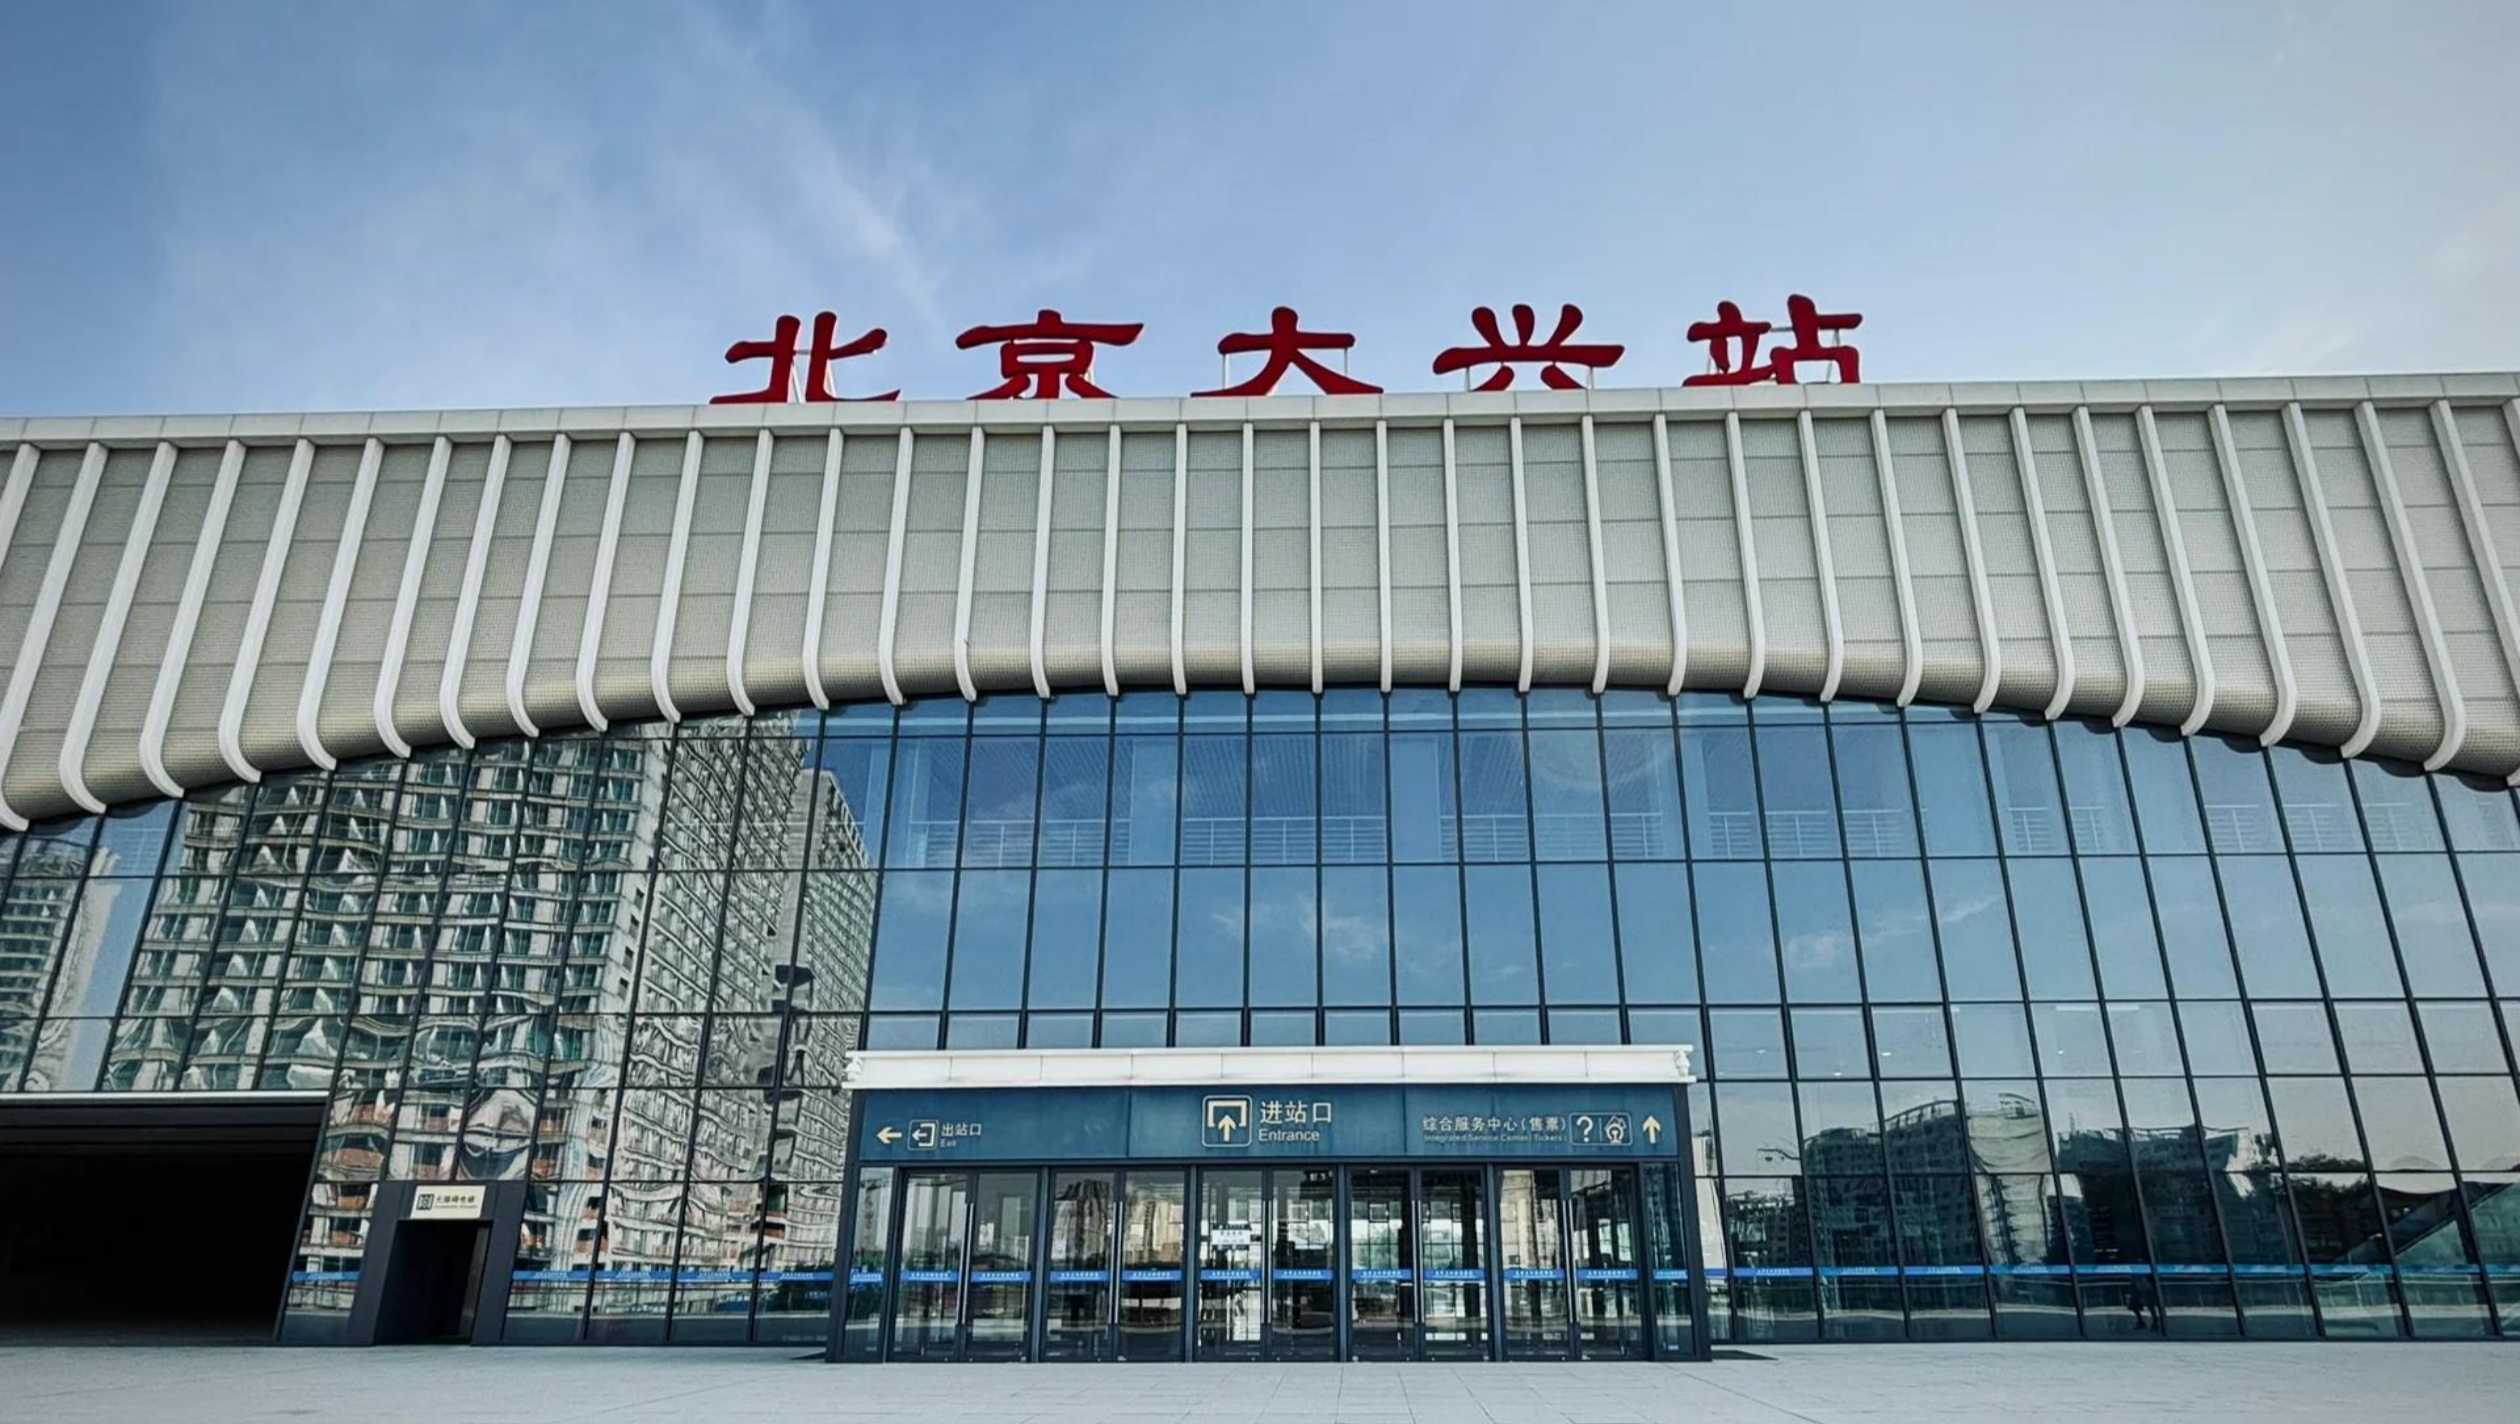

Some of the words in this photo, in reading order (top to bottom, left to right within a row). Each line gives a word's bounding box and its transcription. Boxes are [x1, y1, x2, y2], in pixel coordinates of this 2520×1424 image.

[710, 294, 1864, 404] 北京大兴站
[1259, 1100, 1332, 1124] 进站口
[940, 1122, 983, 1137] 出站口
[1258, 1128, 1320, 1142] Entrance
